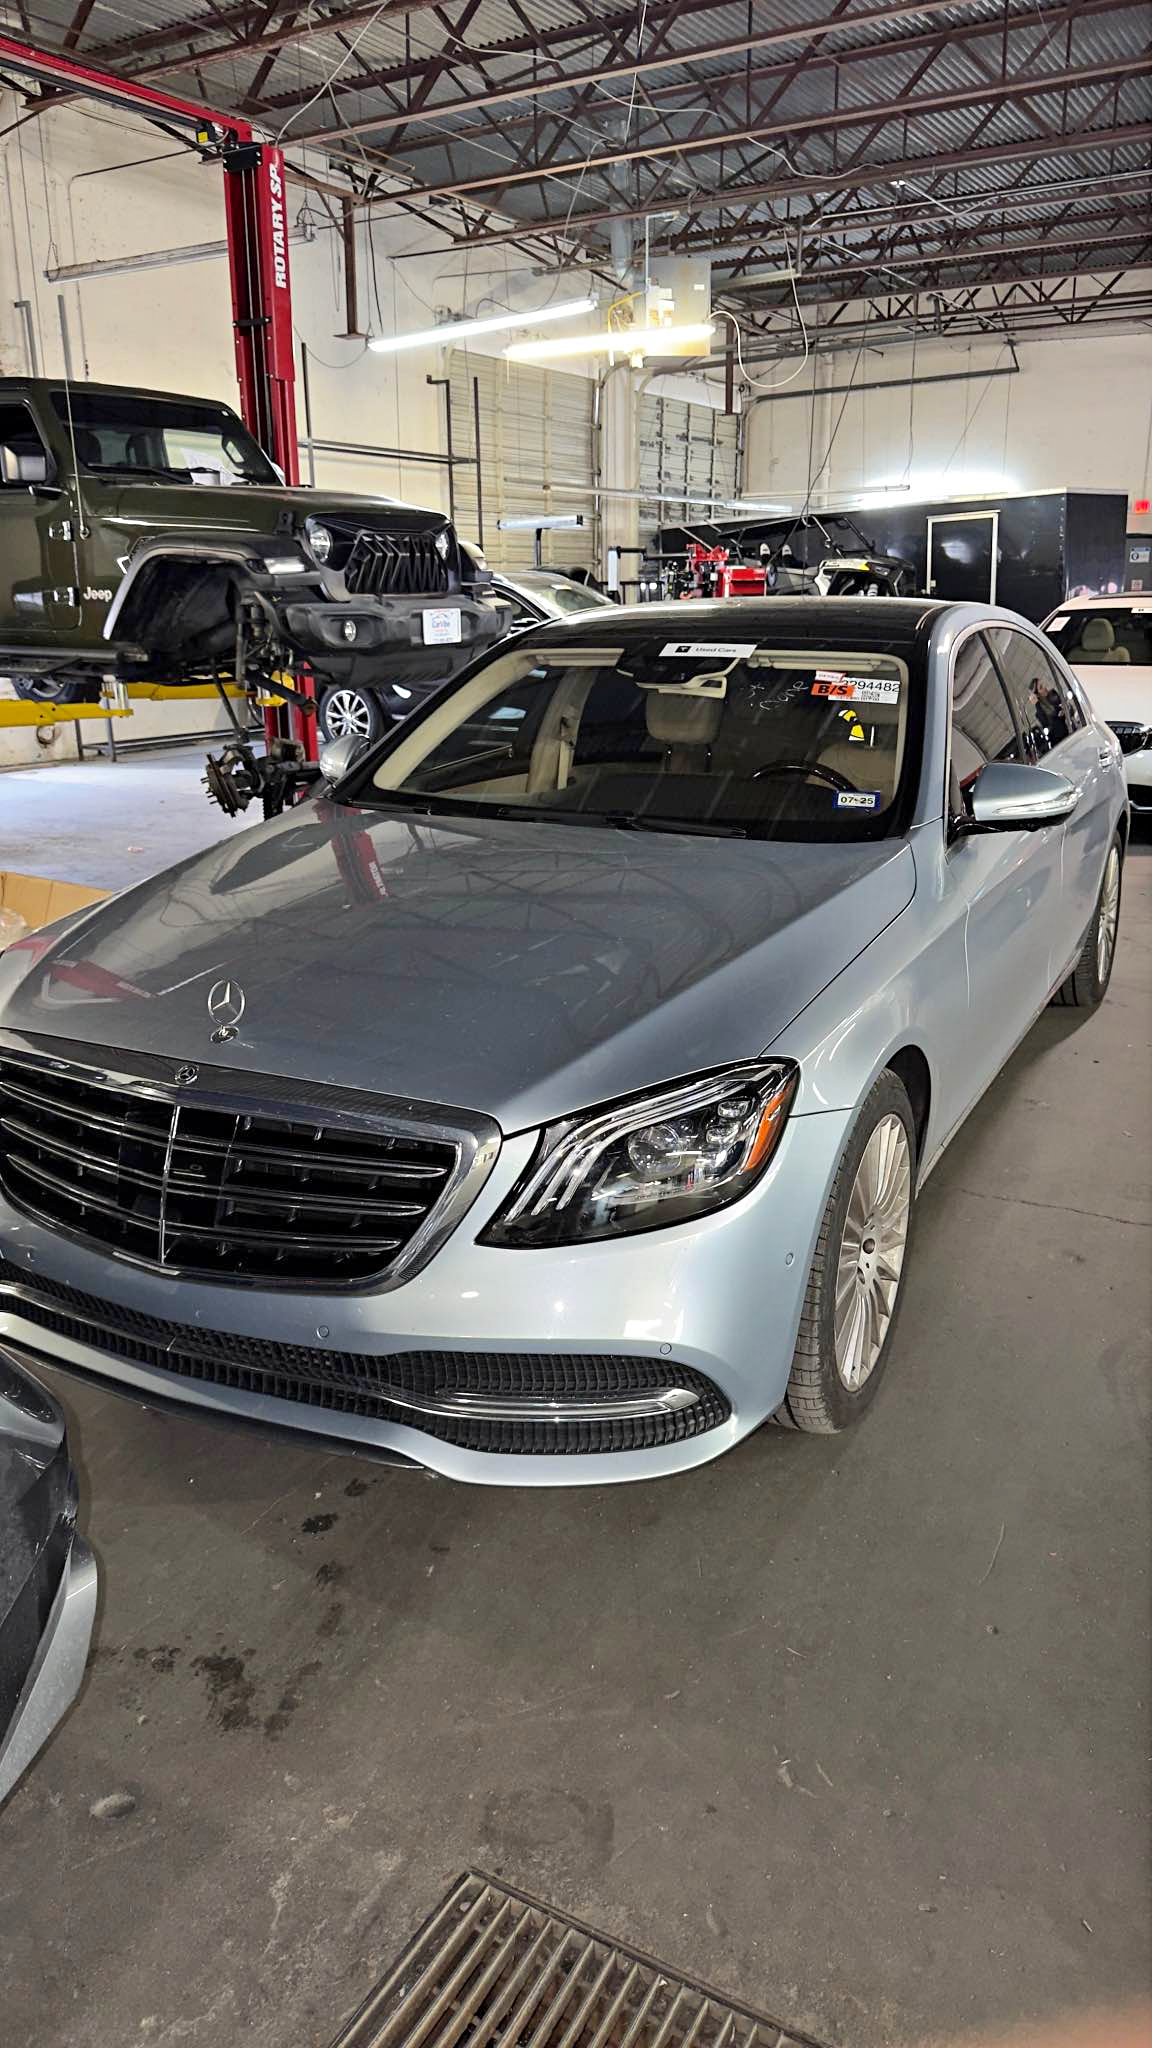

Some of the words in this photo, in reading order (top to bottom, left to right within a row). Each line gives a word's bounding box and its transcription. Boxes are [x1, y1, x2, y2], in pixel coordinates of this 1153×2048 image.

[271, 197, 287, 288] ROTARY
[83, 586, 113, 602] Jeep
[818, 684, 848, 695] B/S
